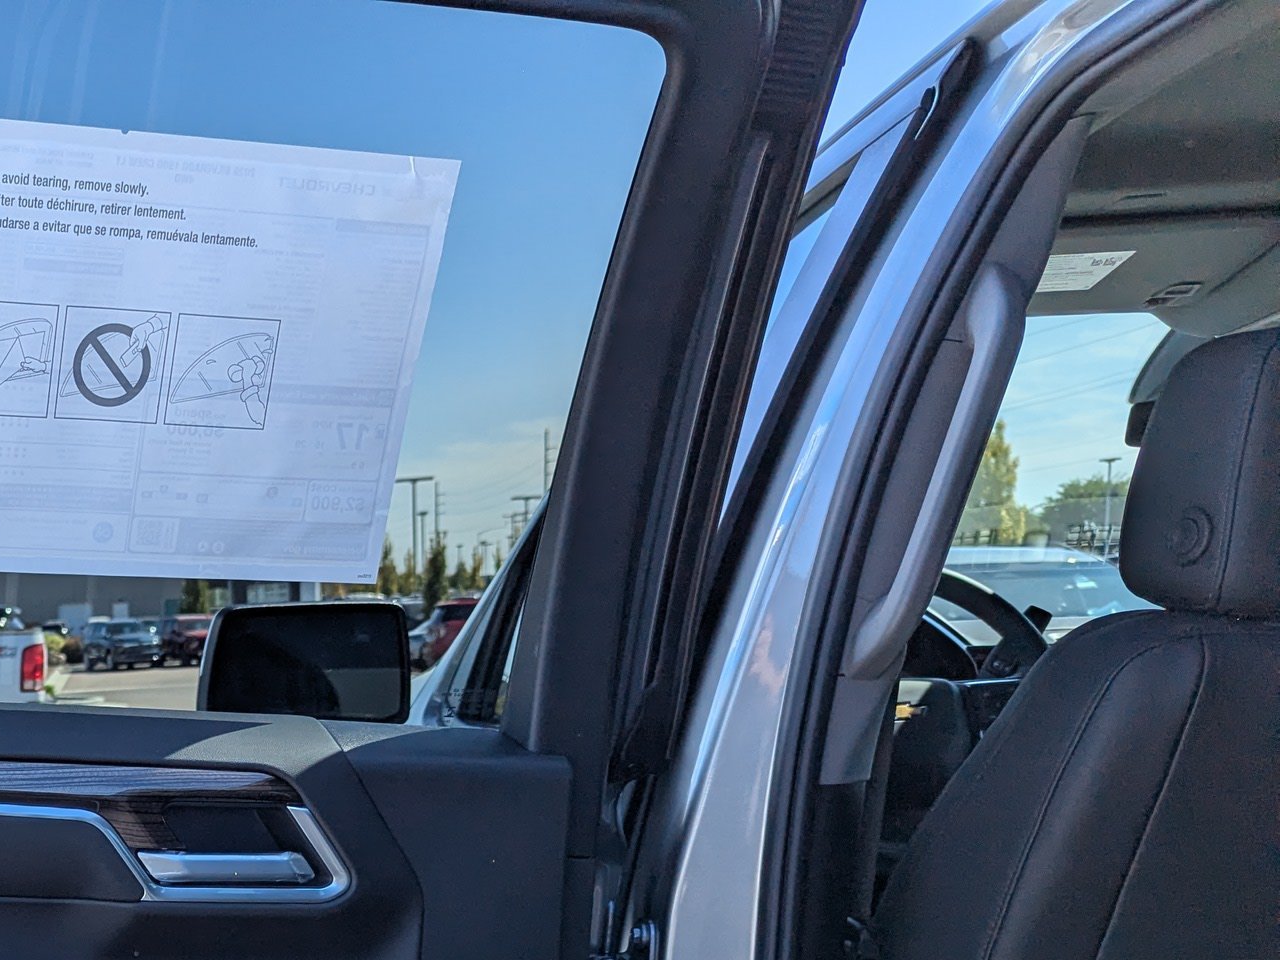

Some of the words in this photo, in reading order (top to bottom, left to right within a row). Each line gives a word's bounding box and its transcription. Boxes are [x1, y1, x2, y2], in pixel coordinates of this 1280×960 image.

[1, 172, 30, 186] avoid
[32, 174, 71, 191] tearing,
[74, 180, 112, 192] remove
[114, 180, 149, 198] slowly.
[18, 195, 44, 209] toute
[46, 197, 97, 215] déchirure,
[100, 202, 132, 216] retirer
[133, 204, 186, 220] lentement.
[32, 220, 40, 231] a
[42, 220, 72, 233] evitar
[73, 224, 92, 236] que
[94, 225, 107, 236] se
[108, 227, 144, 240] rompa,
[146, 228, 199, 243] remuévala
[200, 232, 258, 248] lentamente.
